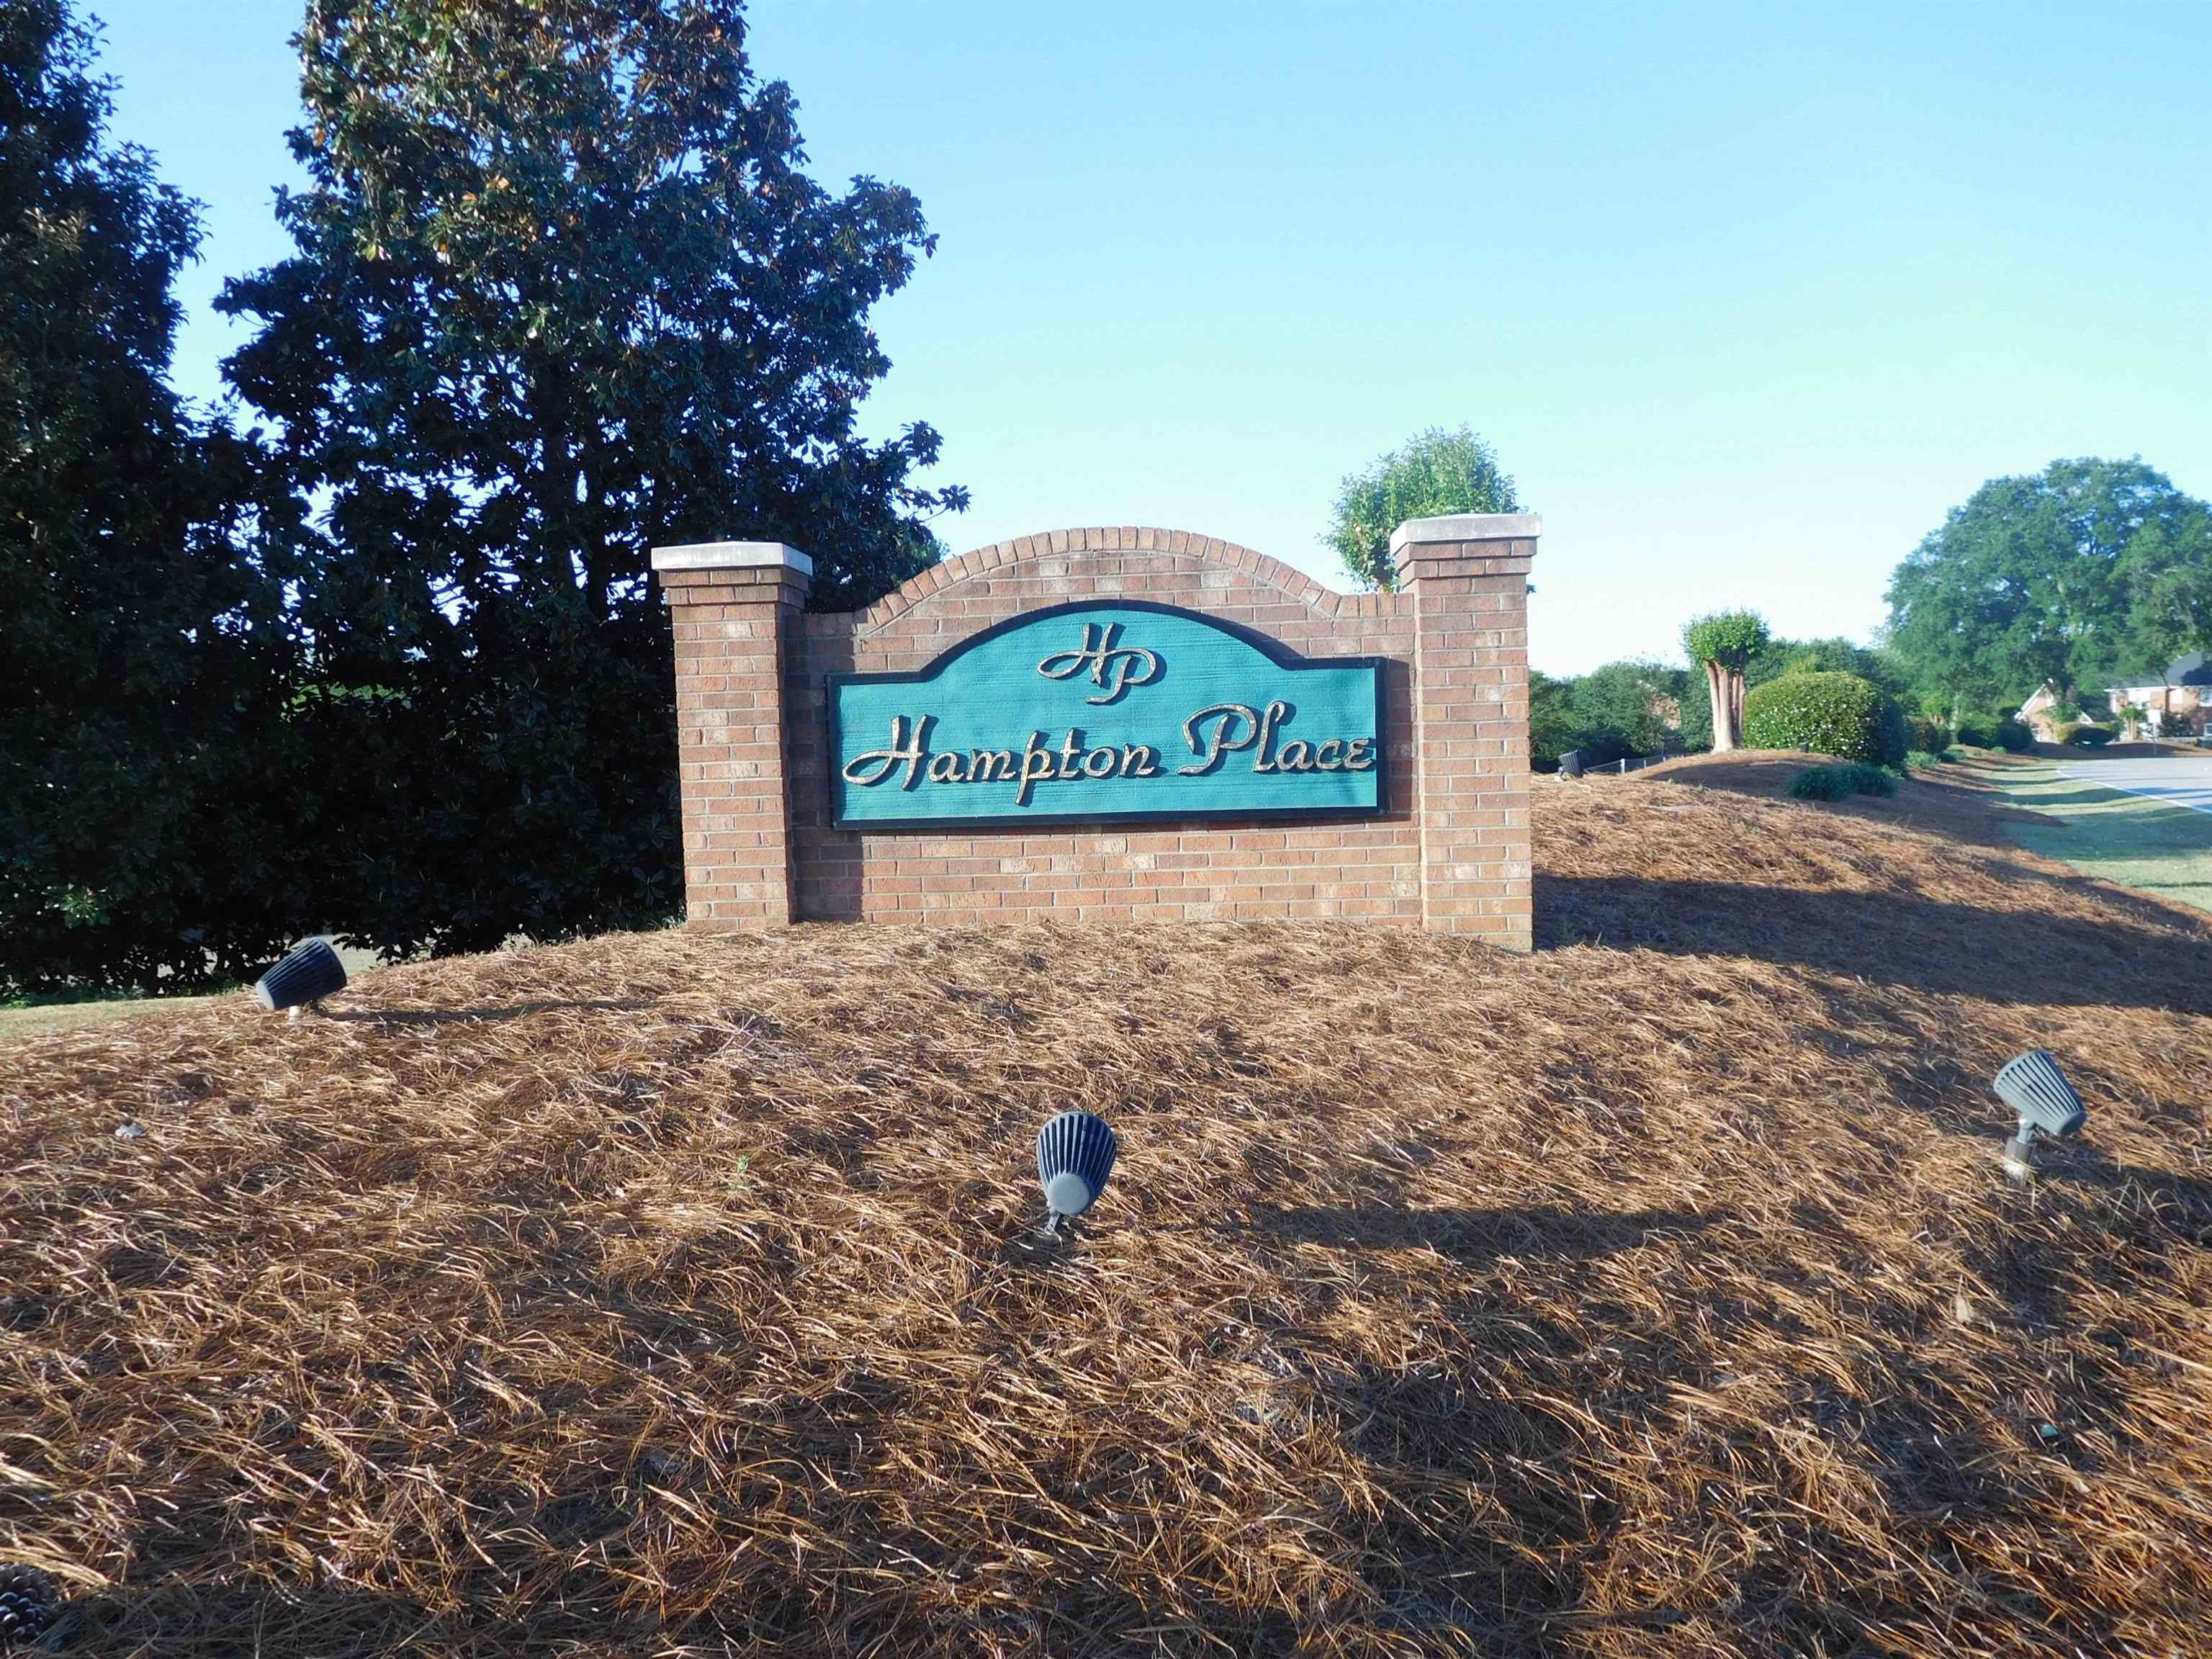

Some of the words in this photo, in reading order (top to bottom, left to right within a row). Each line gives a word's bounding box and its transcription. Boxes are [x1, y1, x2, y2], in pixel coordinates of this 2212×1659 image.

[1038, 622, 1157, 704] HP
[842, 714, 1155, 806] Hampton
[1176, 700, 1376, 775] Place
